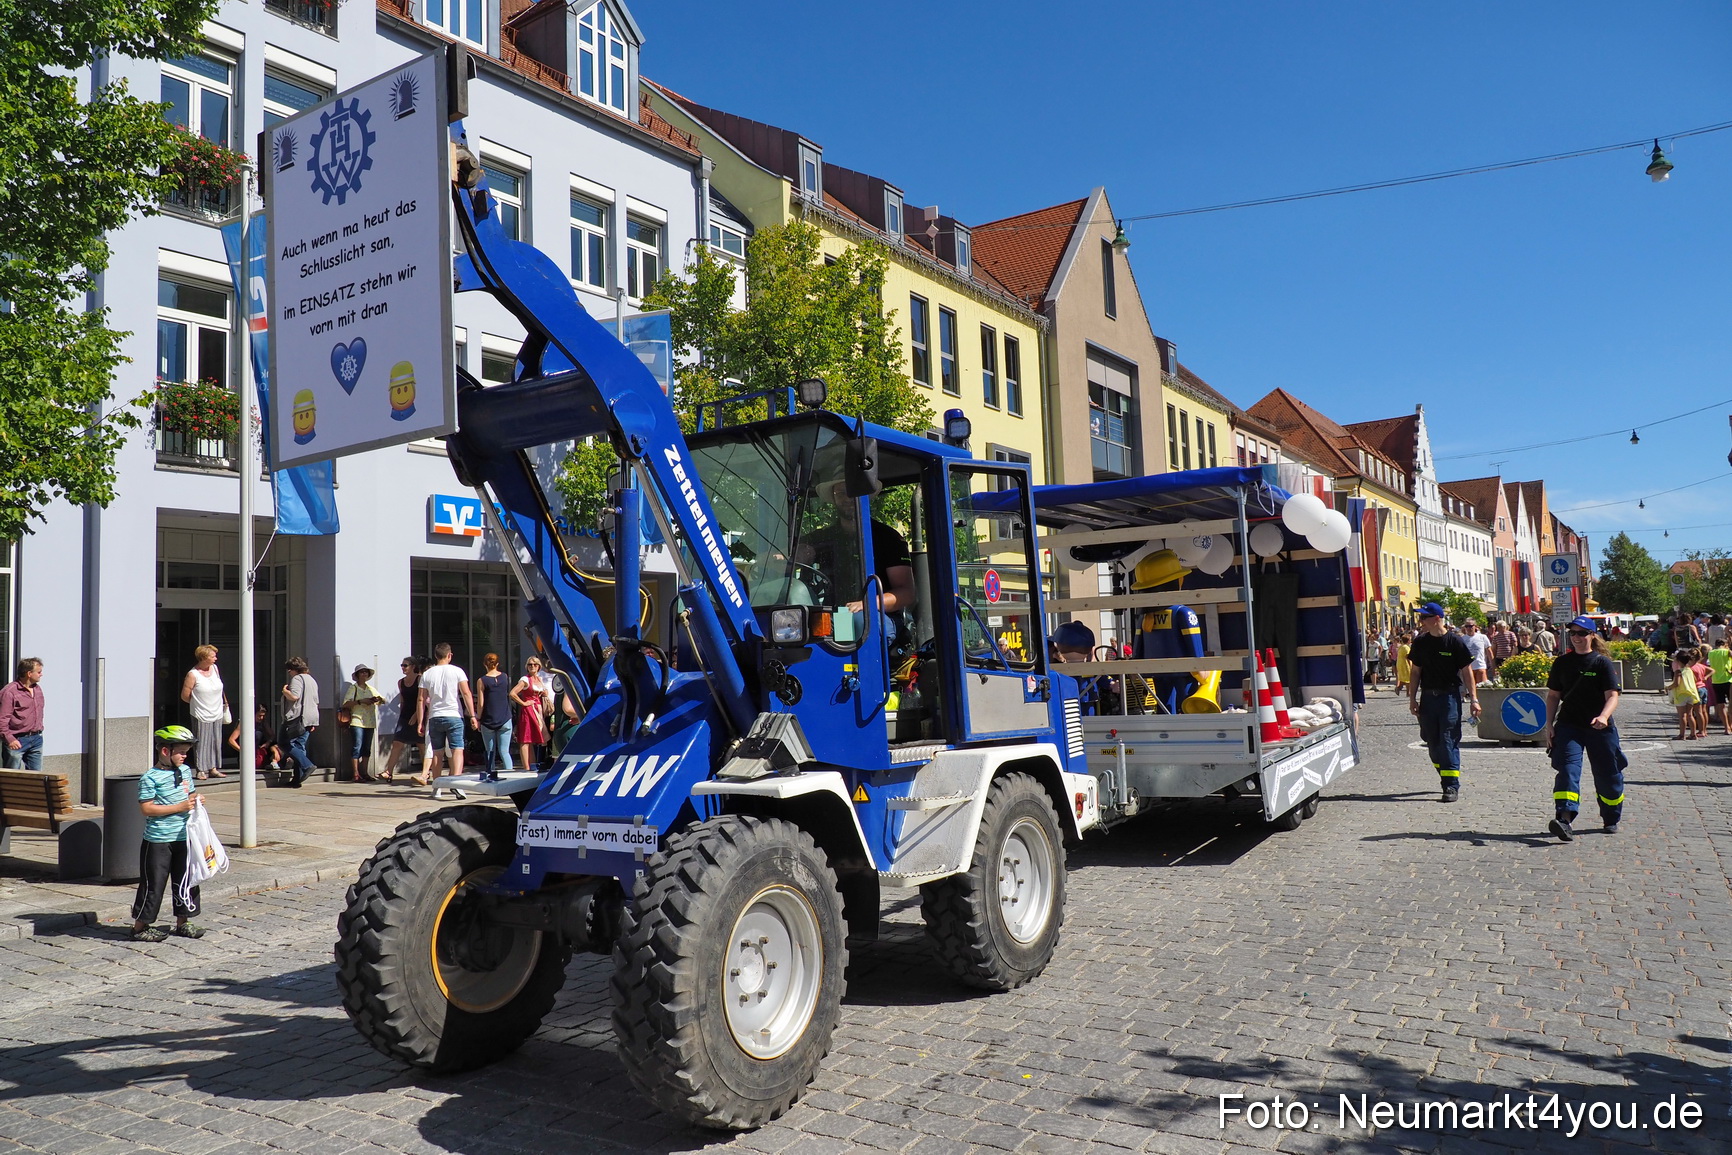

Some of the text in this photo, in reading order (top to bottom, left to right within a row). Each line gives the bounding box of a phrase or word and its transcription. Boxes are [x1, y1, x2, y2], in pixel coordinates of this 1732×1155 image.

[281, 200, 417, 261] Auch wenn ma heut das
[300, 236, 394, 278] Schlusslicht san,
[284, 263, 417, 320] im EINSATZ stehn wir
[309, 301, 388, 336] vorn mit dran
[663, 443, 744, 609] Zettelmeyer
[549, 754, 681, 798] THW
[518, 824, 656, 845] (Fast) immer vorn dabei
